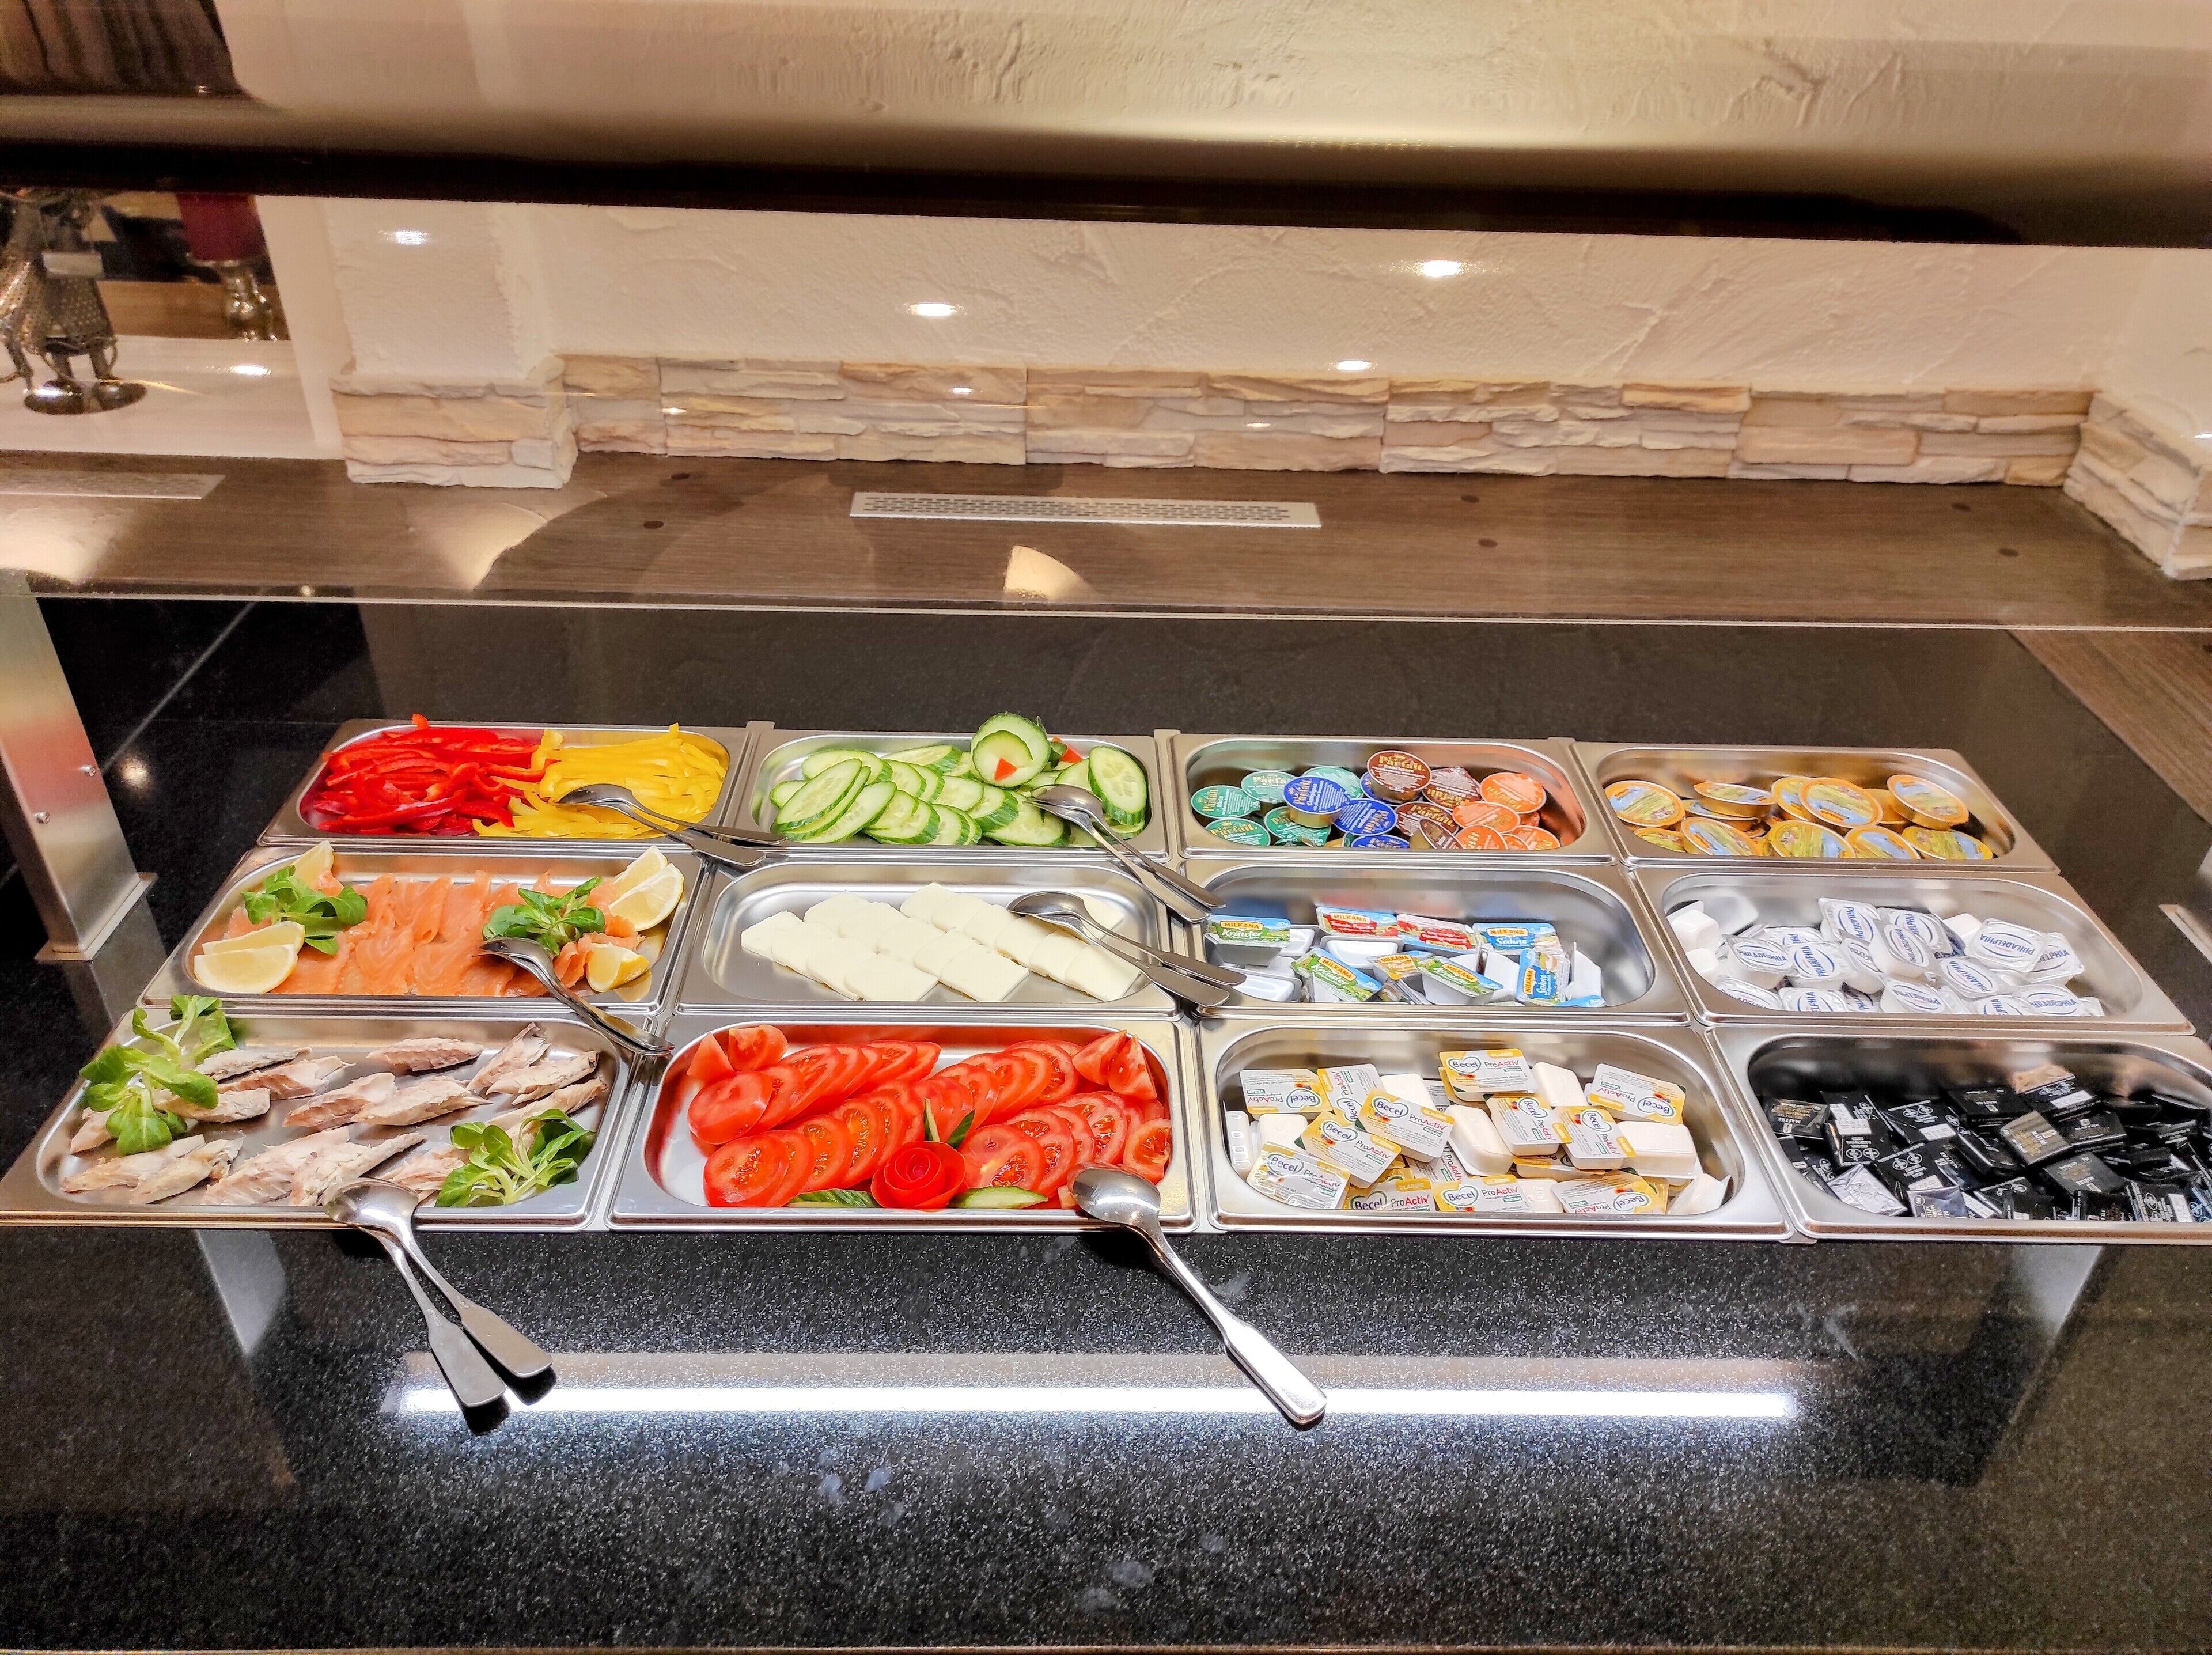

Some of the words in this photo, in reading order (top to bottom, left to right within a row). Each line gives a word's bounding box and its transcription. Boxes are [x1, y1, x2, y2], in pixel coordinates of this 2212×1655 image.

[1334, 914, 1367, 922] MILKANA
[1844, 906, 1865, 939] PHILADELPH
[1221, 928, 1263, 937] Kräuter
[1980, 933, 2036, 955] PHILADELPHIA
[1322, 959, 1352, 979] MILKANA
[1800, 945, 1830, 977] PHILADELPHIA
[1446, 965, 1474, 980] MILKANA
[1525, 970, 1533, 993] MILKANA
[1949, 960, 1993, 992] PHILADELPHIA
[1536, 974, 1548, 996] Sahne
[1331, 1071, 1350, 1096] ProActiv
[1290, 1095, 1316, 1103] Becel
[1597, 1088, 1636, 1103] ProActiv
[1377, 1100, 1404, 1116] Becel
[1409, 1114, 1449, 1131] ProActiv
[1642, 1100, 1670, 1114] Becel
[1523, 1100, 1541, 1116] Becel
[1535, 1119, 1557, 1141] ProActiv
[1326, 1123, 1352, 1140] Becel
[1355, 1140, 1394, 1159] ProActiv
[1587, 1112, 1605, 1129] Becel
[1599, 1133, 1621, 1155] ProActiv
[1271, 1156, 1298, 1173] Becel
[1444, 1154, 1463, 1181] ProActiv
[1355, 1198, 1382, 1210] Becel
[1390, 1194, 1430, 1207] ProActiv
[1448, 1190, 1476, 1202] Becel
[1481, 1186, 1518, 1196] ProActiv
[1616, 1195, 1645, 1209] Becel
